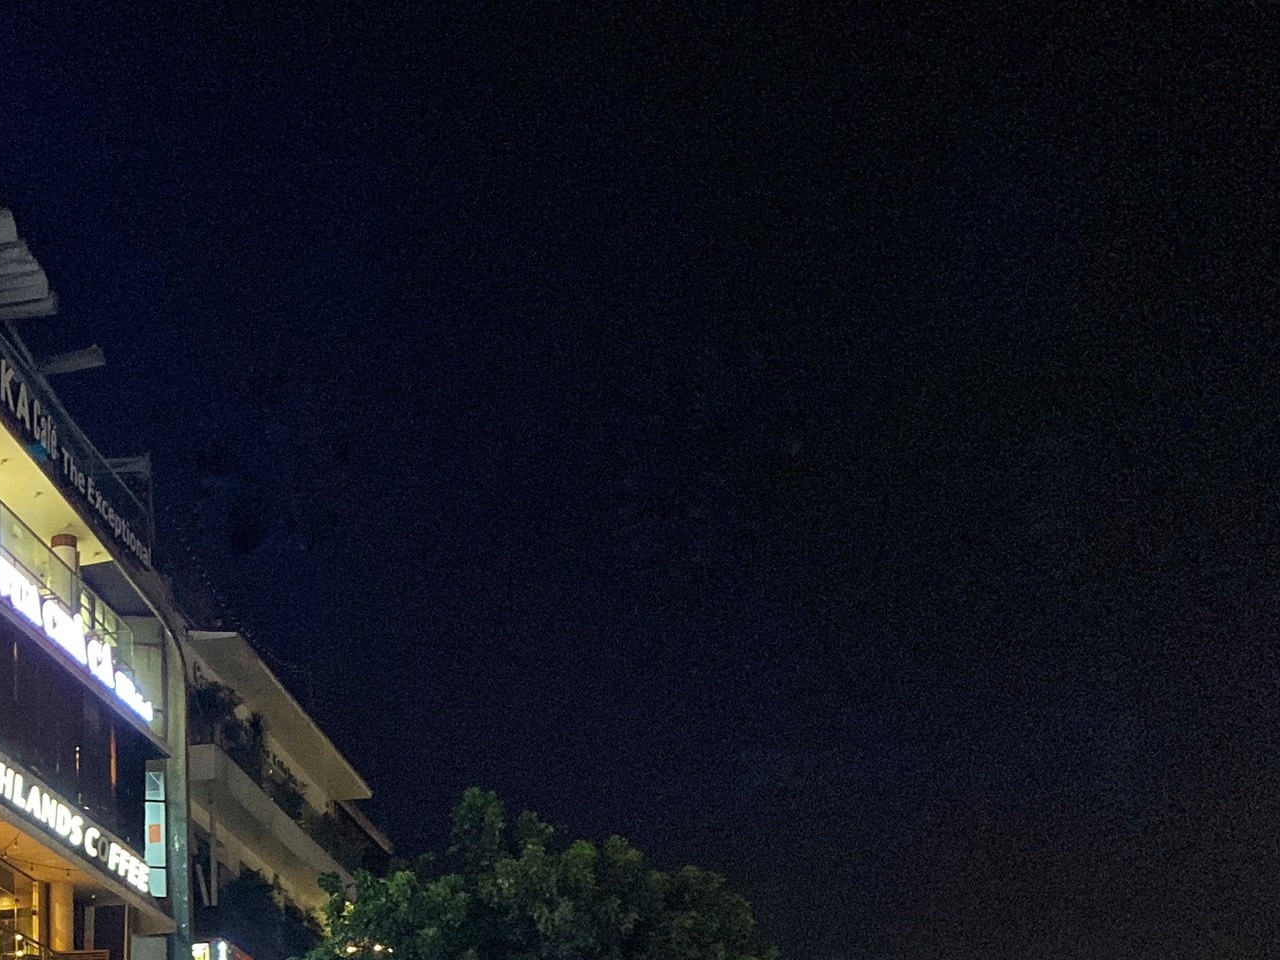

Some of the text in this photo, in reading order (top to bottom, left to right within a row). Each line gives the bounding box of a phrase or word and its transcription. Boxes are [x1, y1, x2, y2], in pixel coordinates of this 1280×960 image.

[33, 399, 60, 461] Café
[61, 446, 86, 494] The
[84, 826, 151, 894] COFFEE
